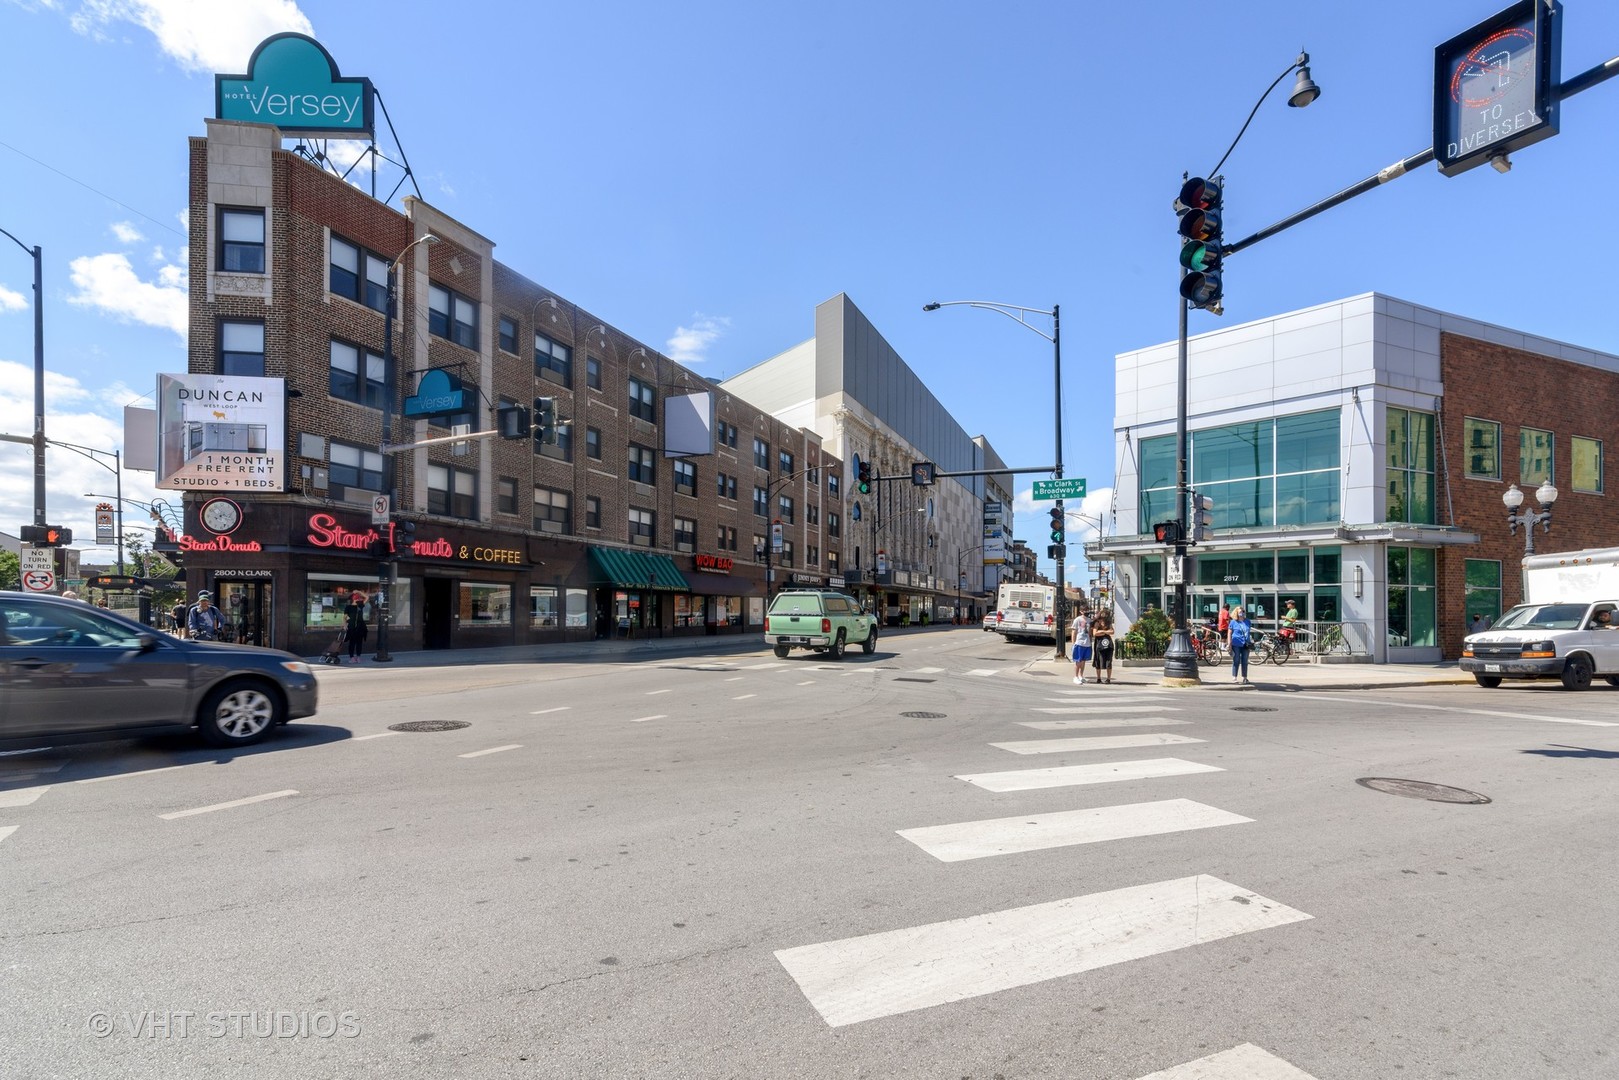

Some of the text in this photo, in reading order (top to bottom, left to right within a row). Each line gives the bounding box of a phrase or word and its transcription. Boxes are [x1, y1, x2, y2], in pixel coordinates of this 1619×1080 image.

[244, 86, 360, 123] Versey
[1480, 104, 1502, 125] TO
[1448, 109, 1537, 159] DIVERSEY
[178, 388, 262, 402] DUNCAN
[420, 395, 457, 409] Versey
[207, 456, 274, 465] 1 MONTH
[239, 466, 274, 474] RENT
[174, 478, 219, 486] STUDIO
[1040, 487, 1075, 495] Broadway
[216, 535, 262, 552] Donuts
[459, 545, 469, 559] &
[473, 547, 521, 564] COFFEE
[696, 554, 734, 570] WOW BAO
